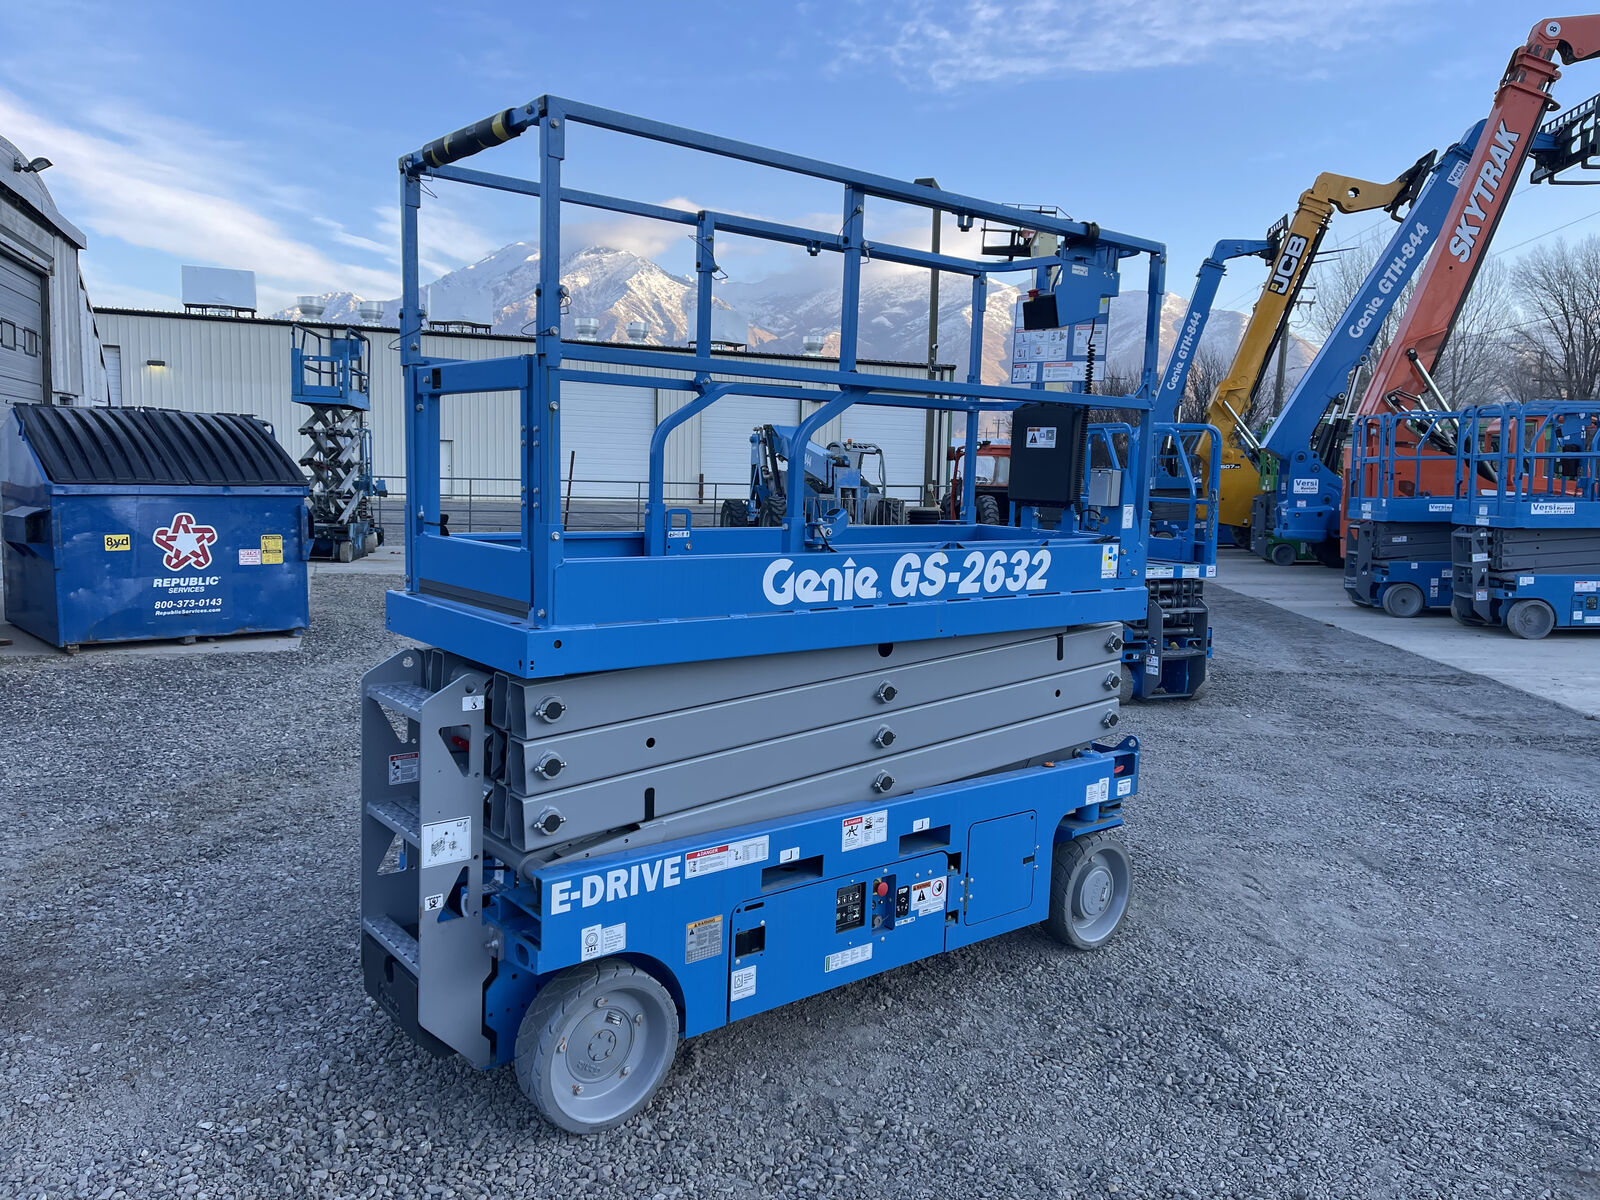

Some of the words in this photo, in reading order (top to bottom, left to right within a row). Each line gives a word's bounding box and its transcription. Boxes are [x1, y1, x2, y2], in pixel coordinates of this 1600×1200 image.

[1449, 161, 1465, 182] Versi
[1449, 118, 1520, 264] SKYTRAK
[1273, 236, 1307, 294] JCB
[1348, 296, 1385, 339] Genie
[1378, 222, 1430, 295] GTH-844
[1167, 361, 1185, 391] Genie
[1178, 311, 1202, 360] GTH-844
[1296, 479, 1318, 487] Versi
[1532, 503, 1556, 511] Versi
[106, 536, 129, 549] 8yd
[152, 576, 219, 588] REPUBLIC
[762, 556, 879, 605] Genie
[890, 549, 1052, 598] GS-2632
[168, 586, 205, 594] SERVICES
[154, 598, 222, 610] 800-373-0143
[155, 607, 221, 616] RepublicServices.com
[700, 848, 719, 857] DANGER
[550, 855, 681, 915] E-DRIVE
